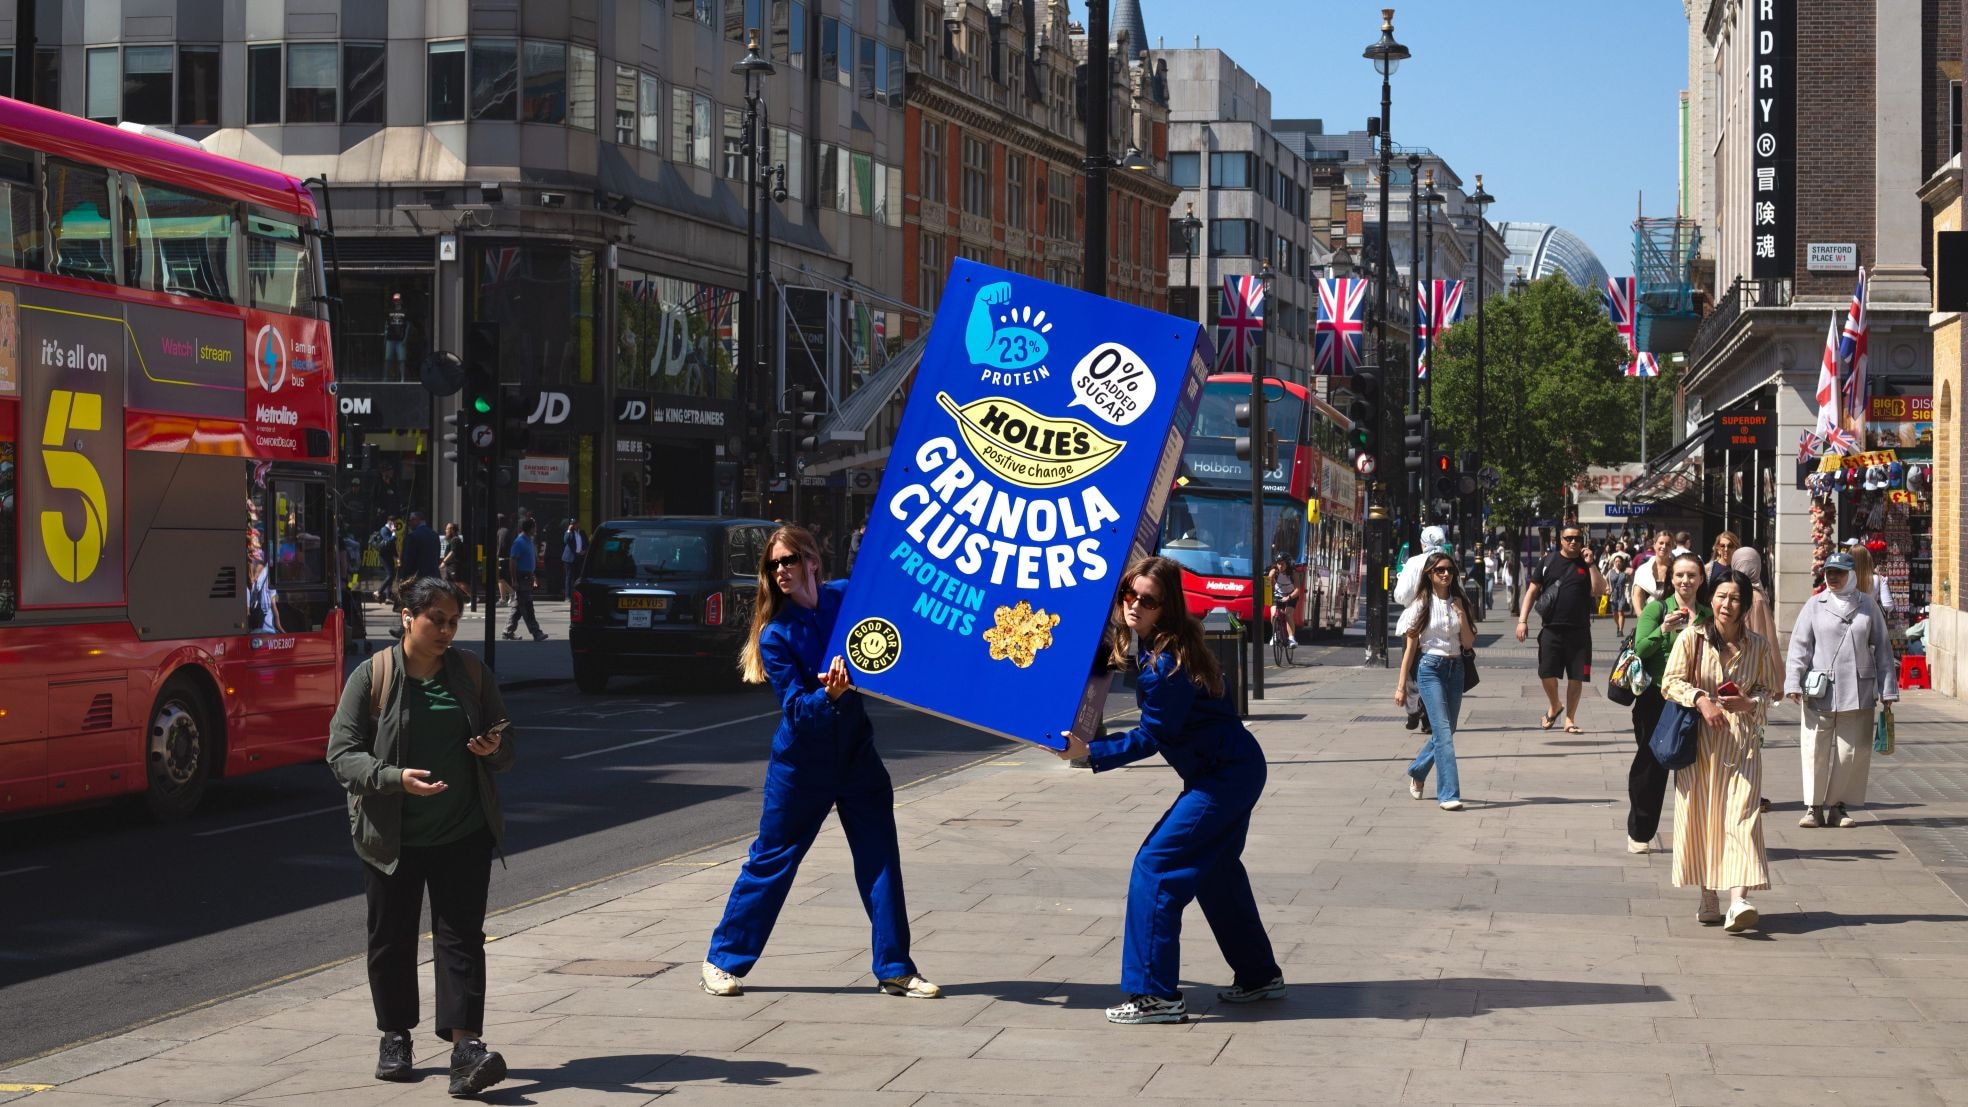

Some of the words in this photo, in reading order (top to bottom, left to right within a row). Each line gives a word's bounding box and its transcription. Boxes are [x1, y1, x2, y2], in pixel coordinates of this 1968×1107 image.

[1756, 167, 1776, 258] 冒険魂
[1811, 246, 1852, 254] STRATFORD
[1811, 254, 1833, 262] PLACE
[1835, 254, 1846, 262] W1
[161, 336, 193, 358] Watch
[200, 345, 232, 363] stream
[295, 341, 306, 353] am
[306, 345, 316, 355] an
[650, 304, 688, 377] JD
[997, 335, 1040, 363] 23%
[41, 338, 64, 367] it's
[67, 343, 84, 370] all
[87, 352, 107, 373] on
[291, 374, 305, 387] bus
[981, 364, 1050, 386] PROTEIN
[1089, 348, 1144, 393] 0%
[527, 391, 571, 425] JD
[1076, 375, 1126, 423] SUGAR
[1100, 379, 1137, 412] ADDED
[1873, 399, 1891, 408] BIG
[255, 404, 298, 426] Metroline
[618, 400, 646, 421] JD
[665, 407, 683, 423] KING
[691, 410, 725, 426] TRAINERS
[1721, 416, 1767, 425] SUPERDRY
[979, 404, 1091, 456] HOLIE'S
[983, 445, 1027, 474] positive
[1027, 464, 1074, 479] change
[1193, 460, 1242, 474] Holborn
[1860, 454, 1874, 467] £1
[1877, 452, 1893, 465] £1
[41, 389, 108, 583] 5
[915, 436, 1120, 542] GRANOLA
[1893, 492, 1912, 504] £1
[889, 483, 1108, 589] CLUSTERS
[889, 540, 986, 611] PROTEIN
[1205, 581, 1245, 592] Metroline
[647, 598, 664, 608] VUS
[912, 592, 977, 636] NUTS
[267, 638, 295, 650] WDE2807
[854, 622, 882, 638] GOOD
[882, 627, 897, 648] FOR
[850, 642, 870, 668] YOUR
[873, 652, 895, 669] GUT.
